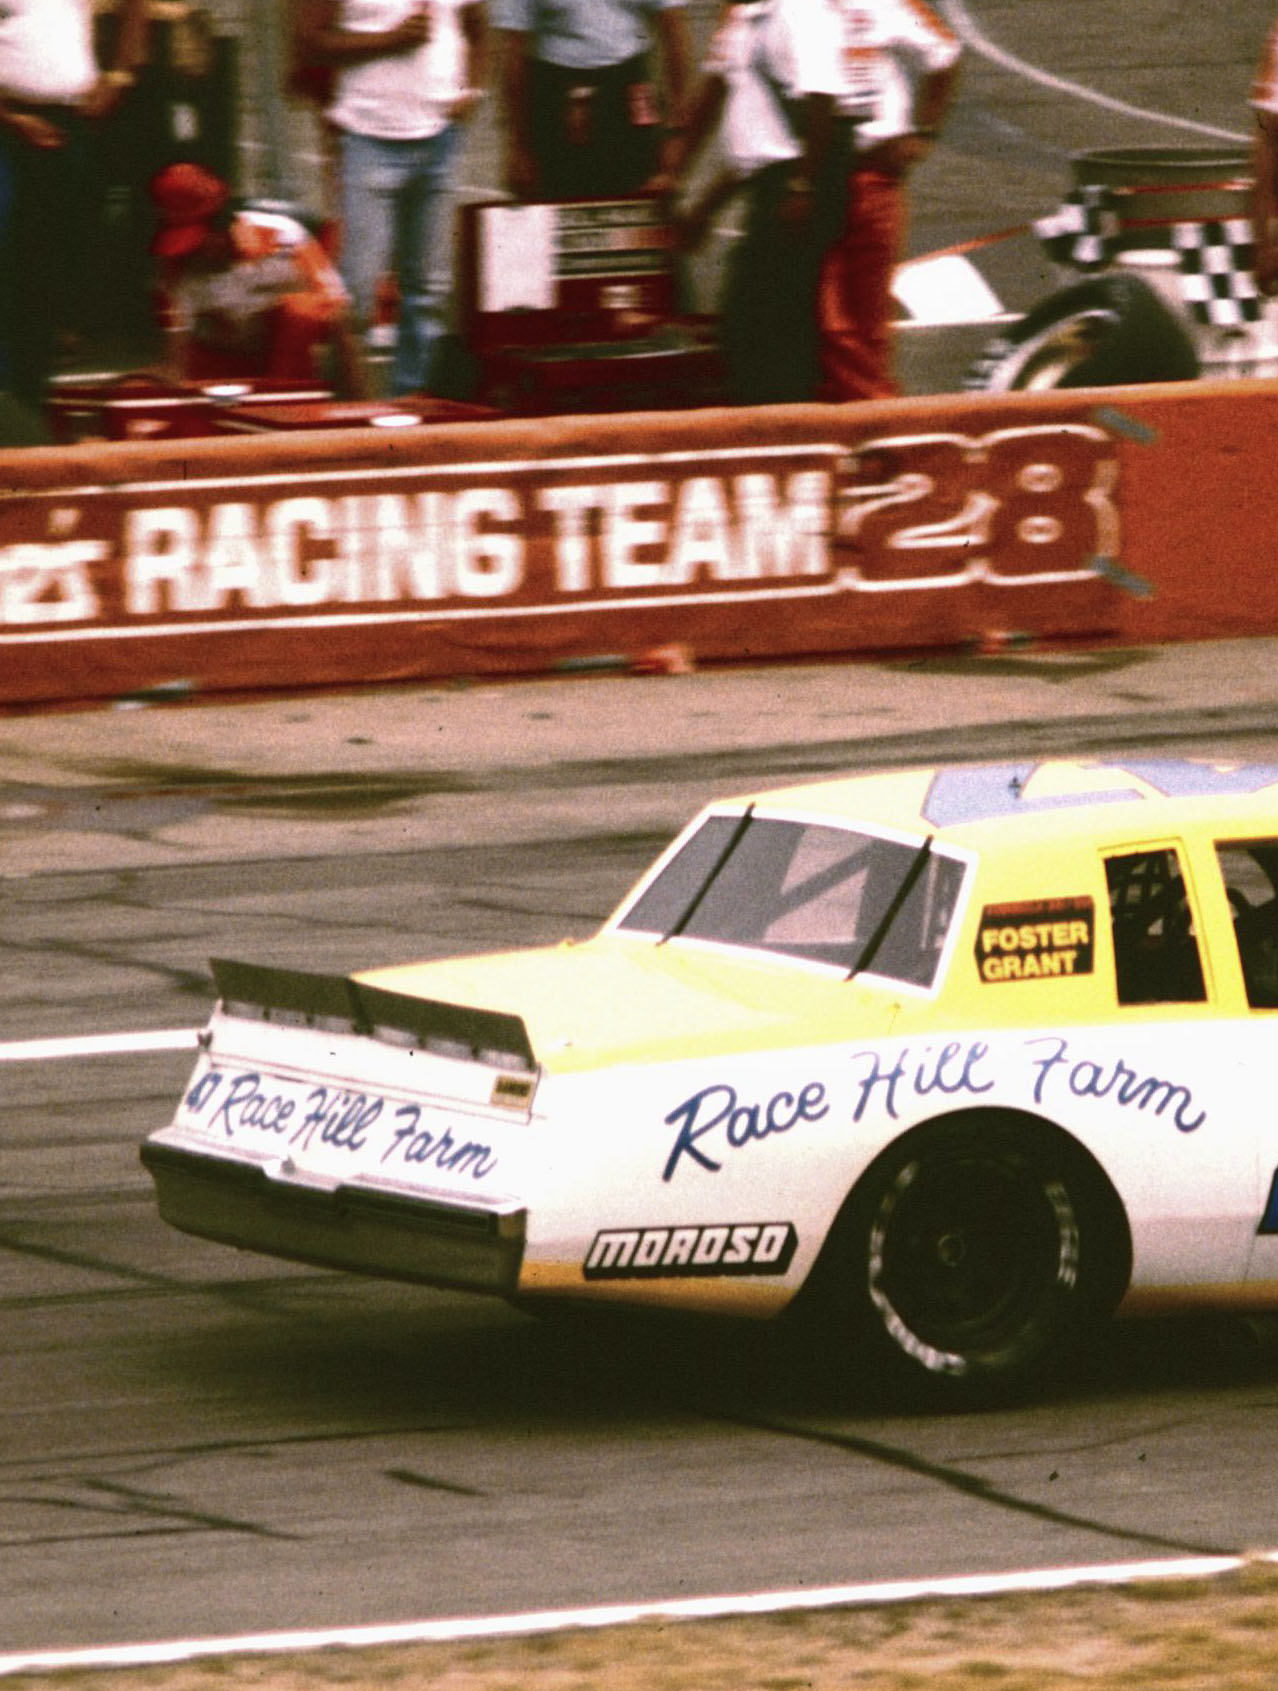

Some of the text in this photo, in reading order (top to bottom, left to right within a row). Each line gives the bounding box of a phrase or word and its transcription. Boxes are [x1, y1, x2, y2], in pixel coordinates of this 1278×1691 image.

[122, 486, 528, 616] RACING
[535, 470, 831, 592] TEAM
[838, 424, 1119, 592] 28
[982, 920, 1089, 953] FOSTER
[983, 950, 1077, 980] GRANT
[208, 1072, 296, 1137] Race
[289, 1087, 384, 1151] Hill
[380, 1102, 498, 1179] Farm
[663, 1036, 1206, 1182] Race Hill Farm
[586, 1225, 790, 1269] MOROSO
